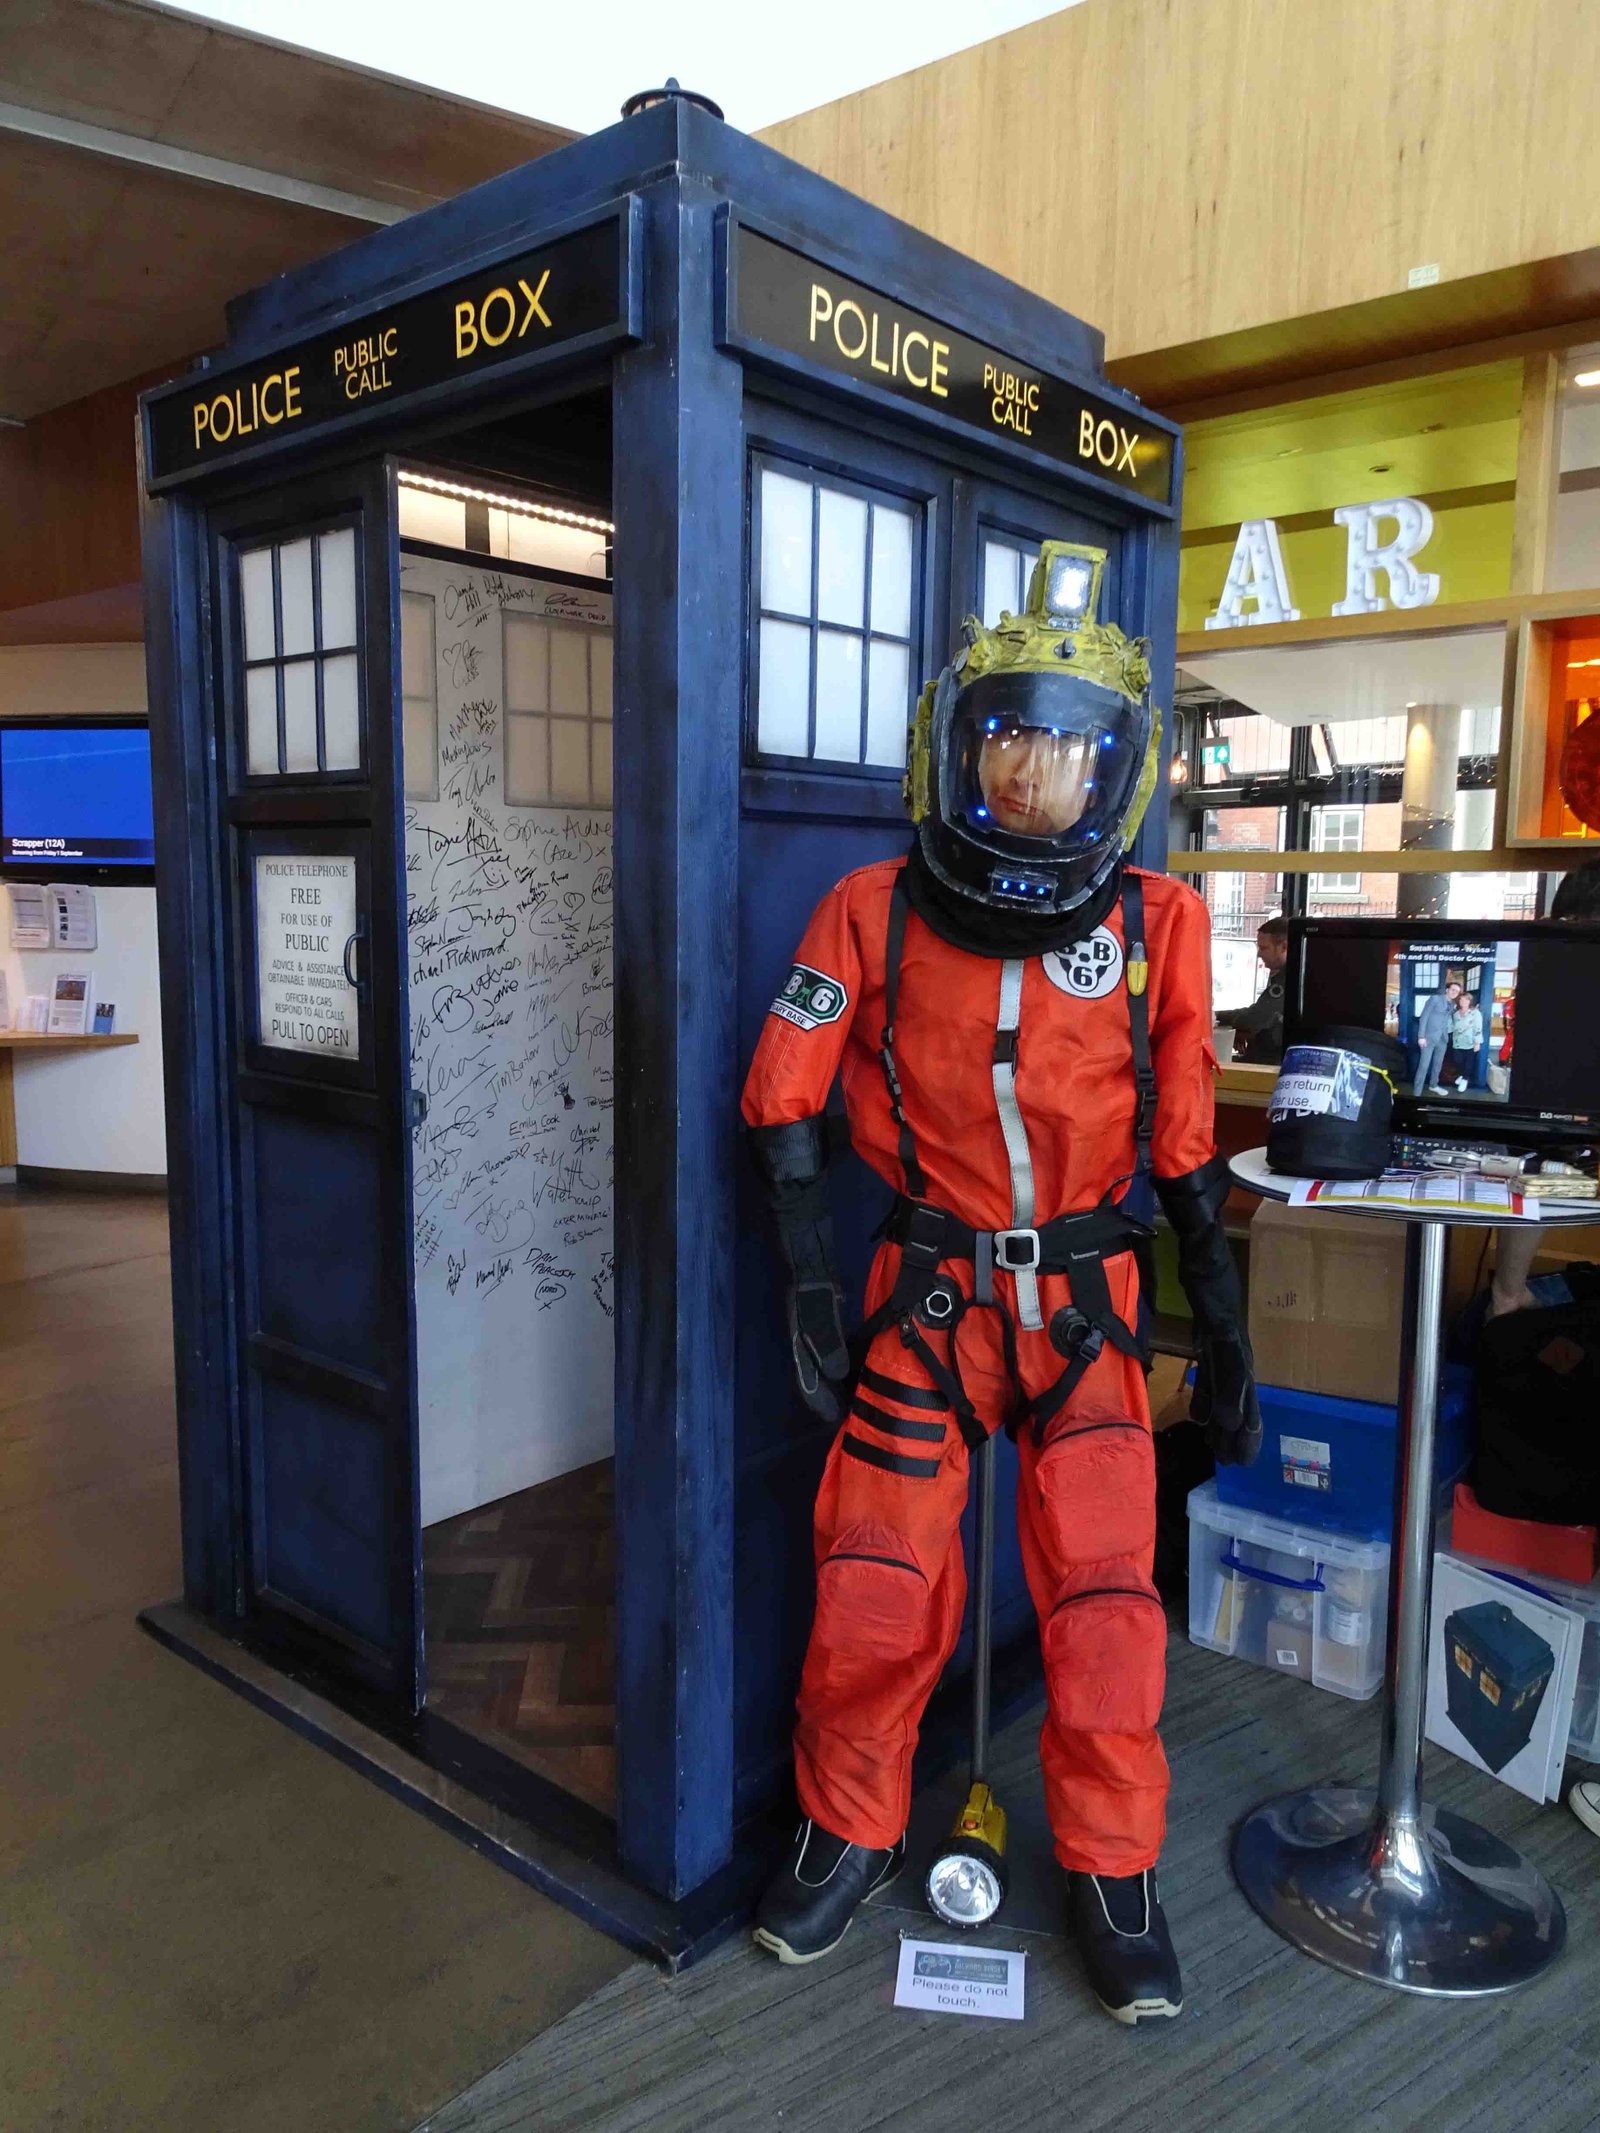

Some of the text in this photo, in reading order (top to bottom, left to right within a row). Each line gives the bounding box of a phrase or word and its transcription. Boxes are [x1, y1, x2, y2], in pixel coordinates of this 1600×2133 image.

[193, 269, 553, 450] POLICE PUBLIC CALL BOX
[809, 283, 1141, 478] POLICE PUBLIC CALL BOX
[12, 839, 65, 849] Scrapper (12A)
[265, 864, 348, 878] POLICE TELEPHONE
[291, 888, 321, 905] FREE
[281, 913, 333, 927] FOR USE OF
[285, 933, 329, 952] PUBLIC
[1093, 940, 1111, 961] B
[272, 959, 345, 976] ADVICE & ASSISTANCE
[1073, 965, 1093, 987] 6
[268, 972, 350, 990] OBTAINABLE IMMEDIATELY
[310, 995, 315, 1005] &
[316, 996, 333, 1007] CARS
[811, 987, 836, 1012] 6
[275, 1002, 345, 1021] RESPOND TO ALL CALLS
[786, 1009, 807, 1026] BASE
[271, 1018, 349, 1048] PULL TO OPEN
[1293, 1080, 1331, 1093] return
[1288, 1097, 1312, 1108] use.
[509, 1114, 560, 1136] Emily Cook
[912, 1976, 1008, 1997] Please do not
[937, 1994, 980, 2009] touch.
